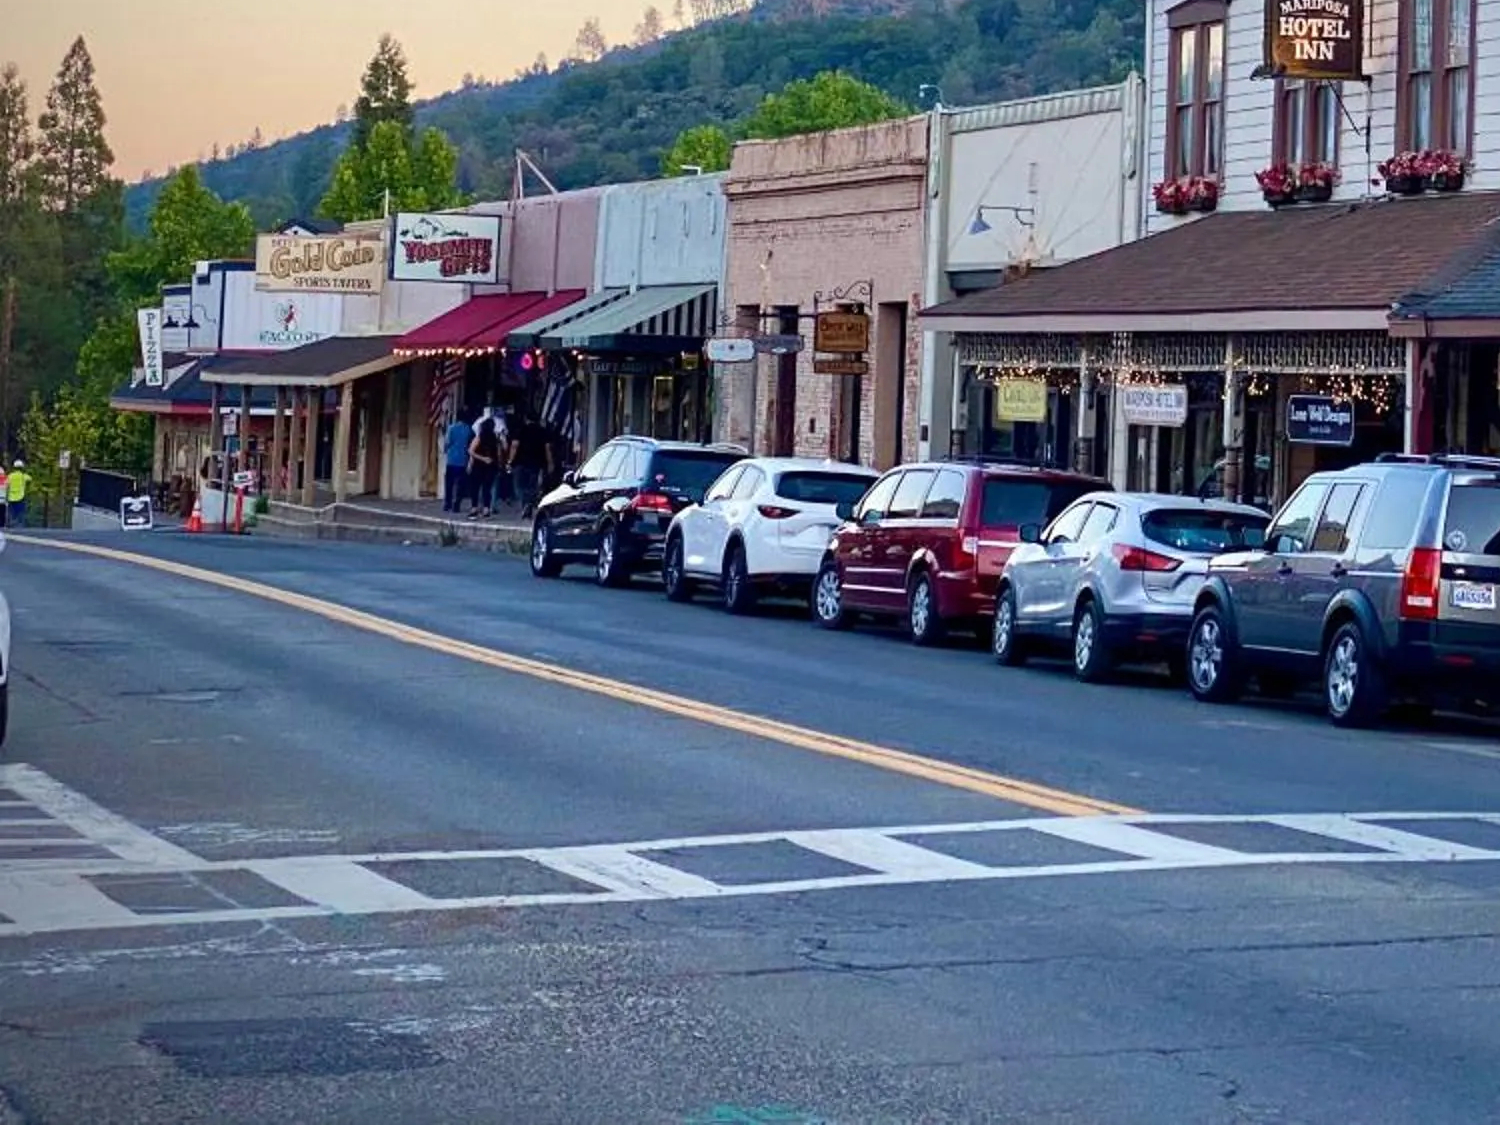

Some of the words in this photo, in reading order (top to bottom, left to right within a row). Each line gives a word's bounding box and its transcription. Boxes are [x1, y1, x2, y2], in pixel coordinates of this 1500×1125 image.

[1280, 17, 1351, 39] HOTEL
[1291, 39, 1336, 60] INN
[270, 242, 325, 279] Gold
[326, 238, 375, 271] Coin
[400, 238, 493, 263] YOSEMITE
[440, 256, 490, 277] GIFTS
[293, 276, 331, 288] SPORTS
[332, 277, 371, 289] TAVERN
[145, 312, 161, 383] PIZZA
